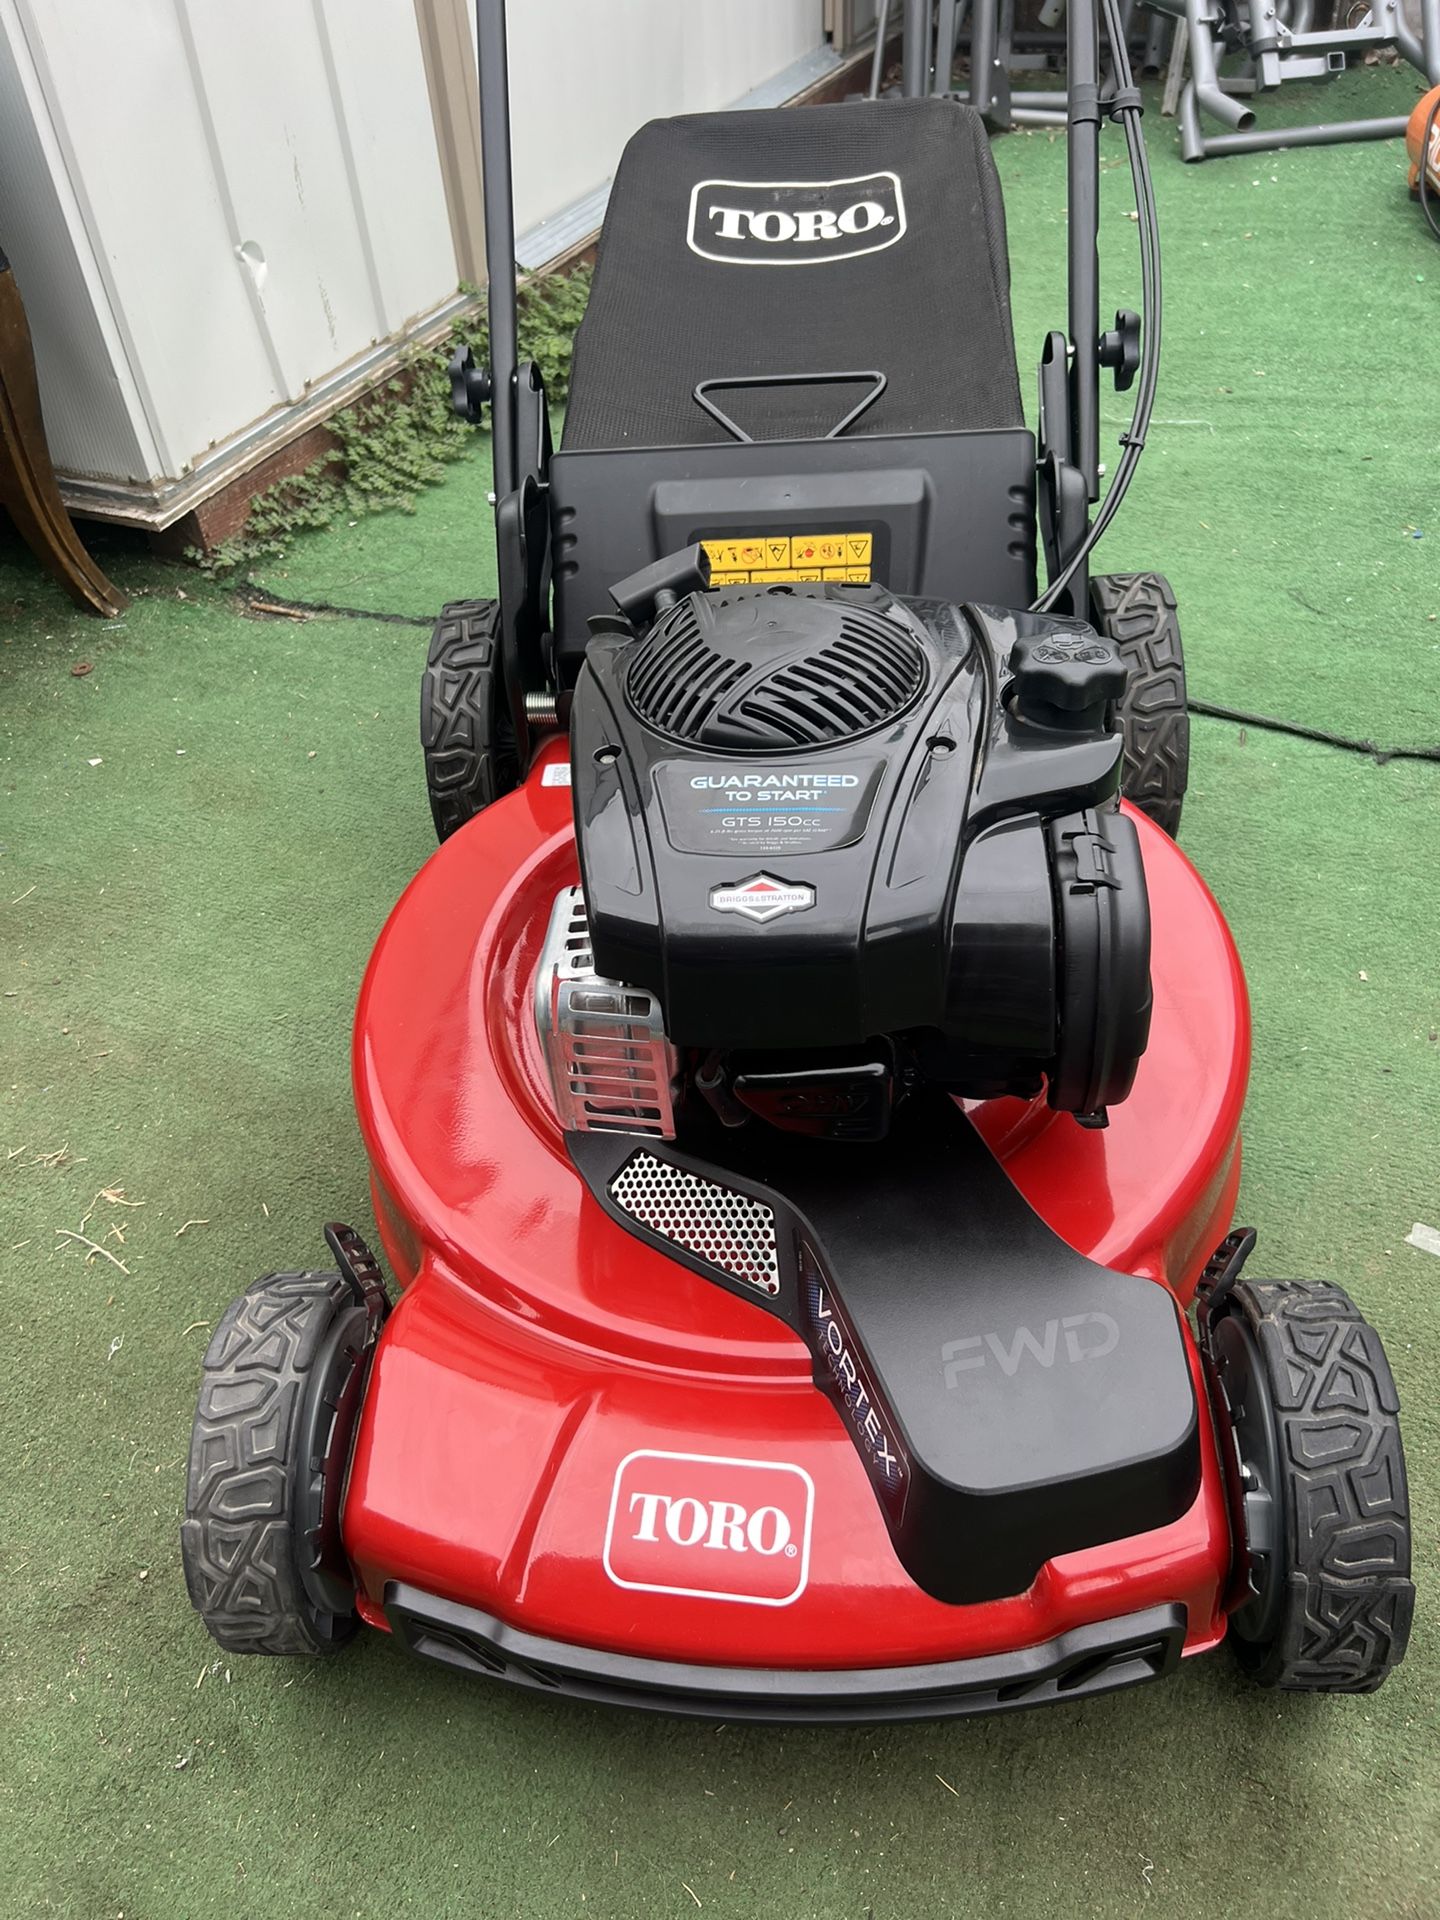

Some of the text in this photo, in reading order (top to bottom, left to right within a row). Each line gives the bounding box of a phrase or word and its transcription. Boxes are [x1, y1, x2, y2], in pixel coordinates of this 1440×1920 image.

[690, 774, 859, 789] GUARANTEED
[725, 790, 752, 802] TO
[721, 816, 762, 828] GTS
[941, 1311, 1121, 1391] FWD
